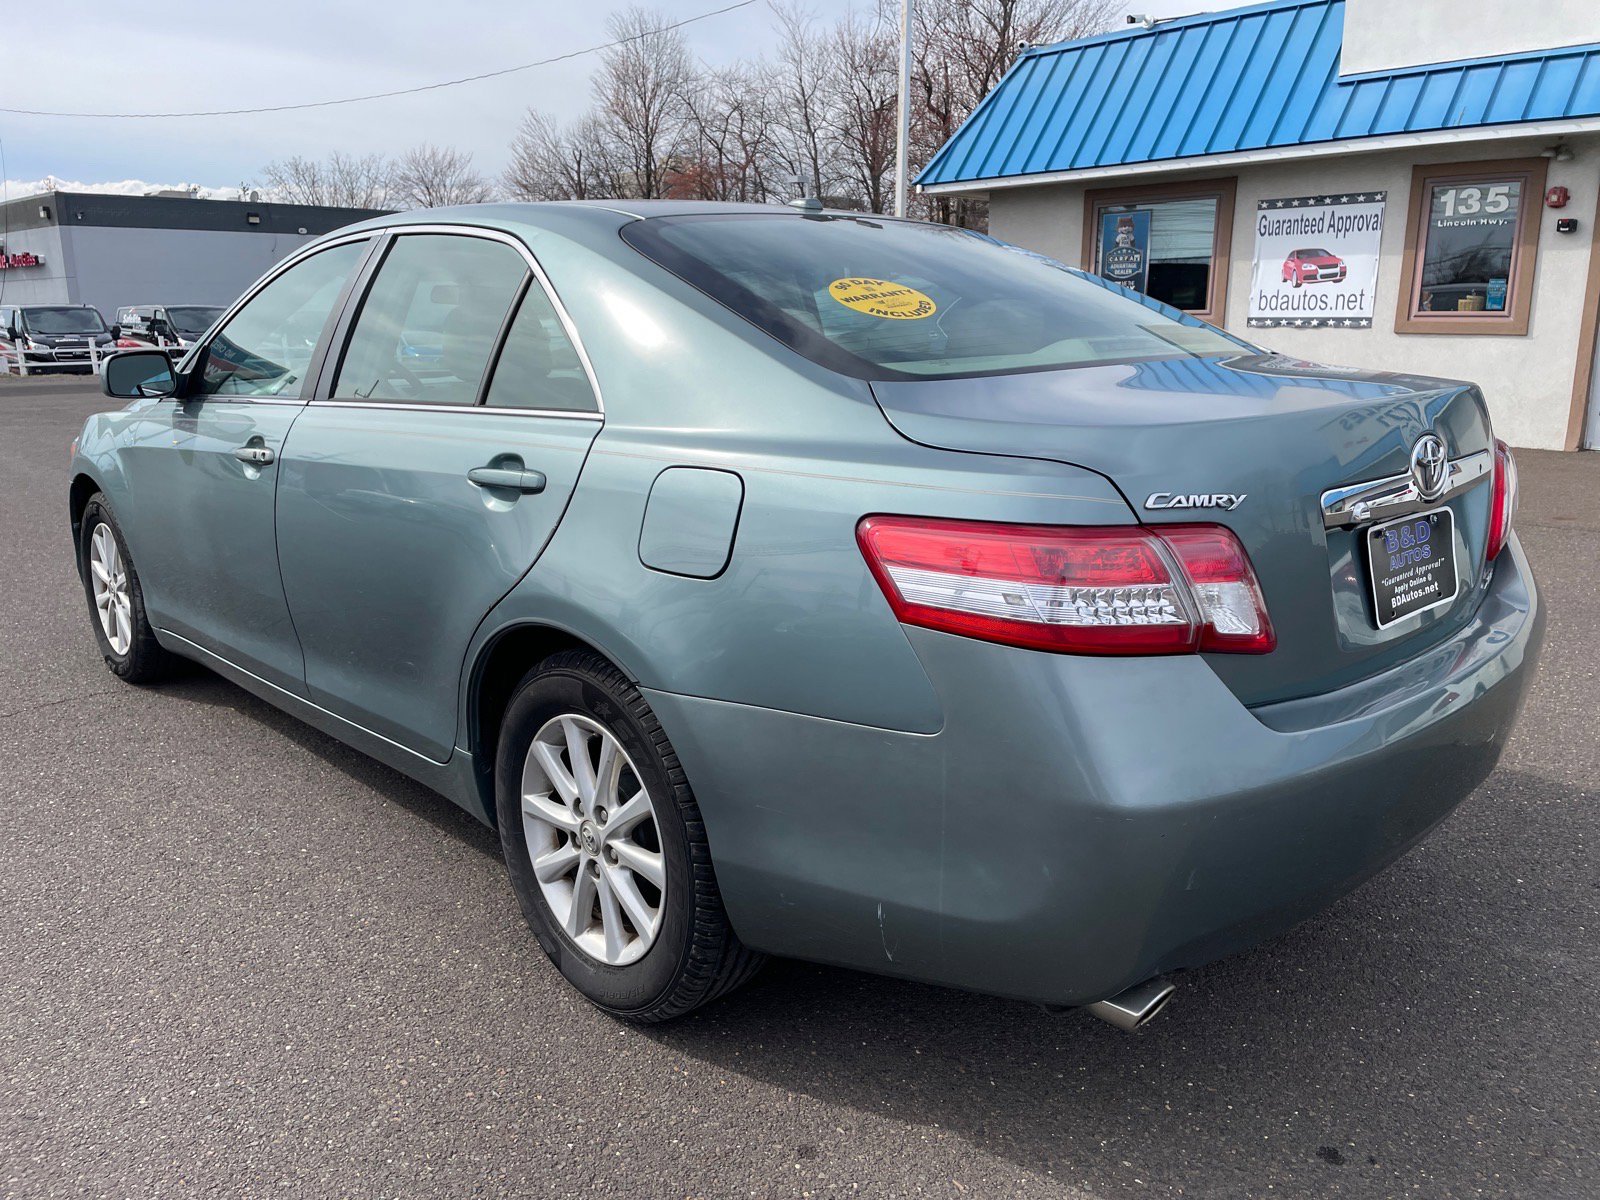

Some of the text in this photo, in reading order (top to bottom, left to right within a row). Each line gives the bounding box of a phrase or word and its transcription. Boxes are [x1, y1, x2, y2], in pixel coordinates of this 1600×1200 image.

[1440, 186, 1510, 217] 135
[1259, 207, 1384, 239] Guaranteed Approval
[1437, 218, 1508, 228] Lincoln Hwy.
[840, 289, 914, 304] WARRANTY
[869, 300, 932, 317] INCLUDED
[1258, 288, 1365, 312] bdautos.net
[1144, 492, 1248, 511] CAMRY
[1385, 520, 1431, 553] B&D
[1389, 544, 1431, 571] AUTOS
[1391, 581, 1439, 609] BDAutos.net
[1394, 582, 1409, 594] Apply
[1409, 576, 1427, 587] Online
